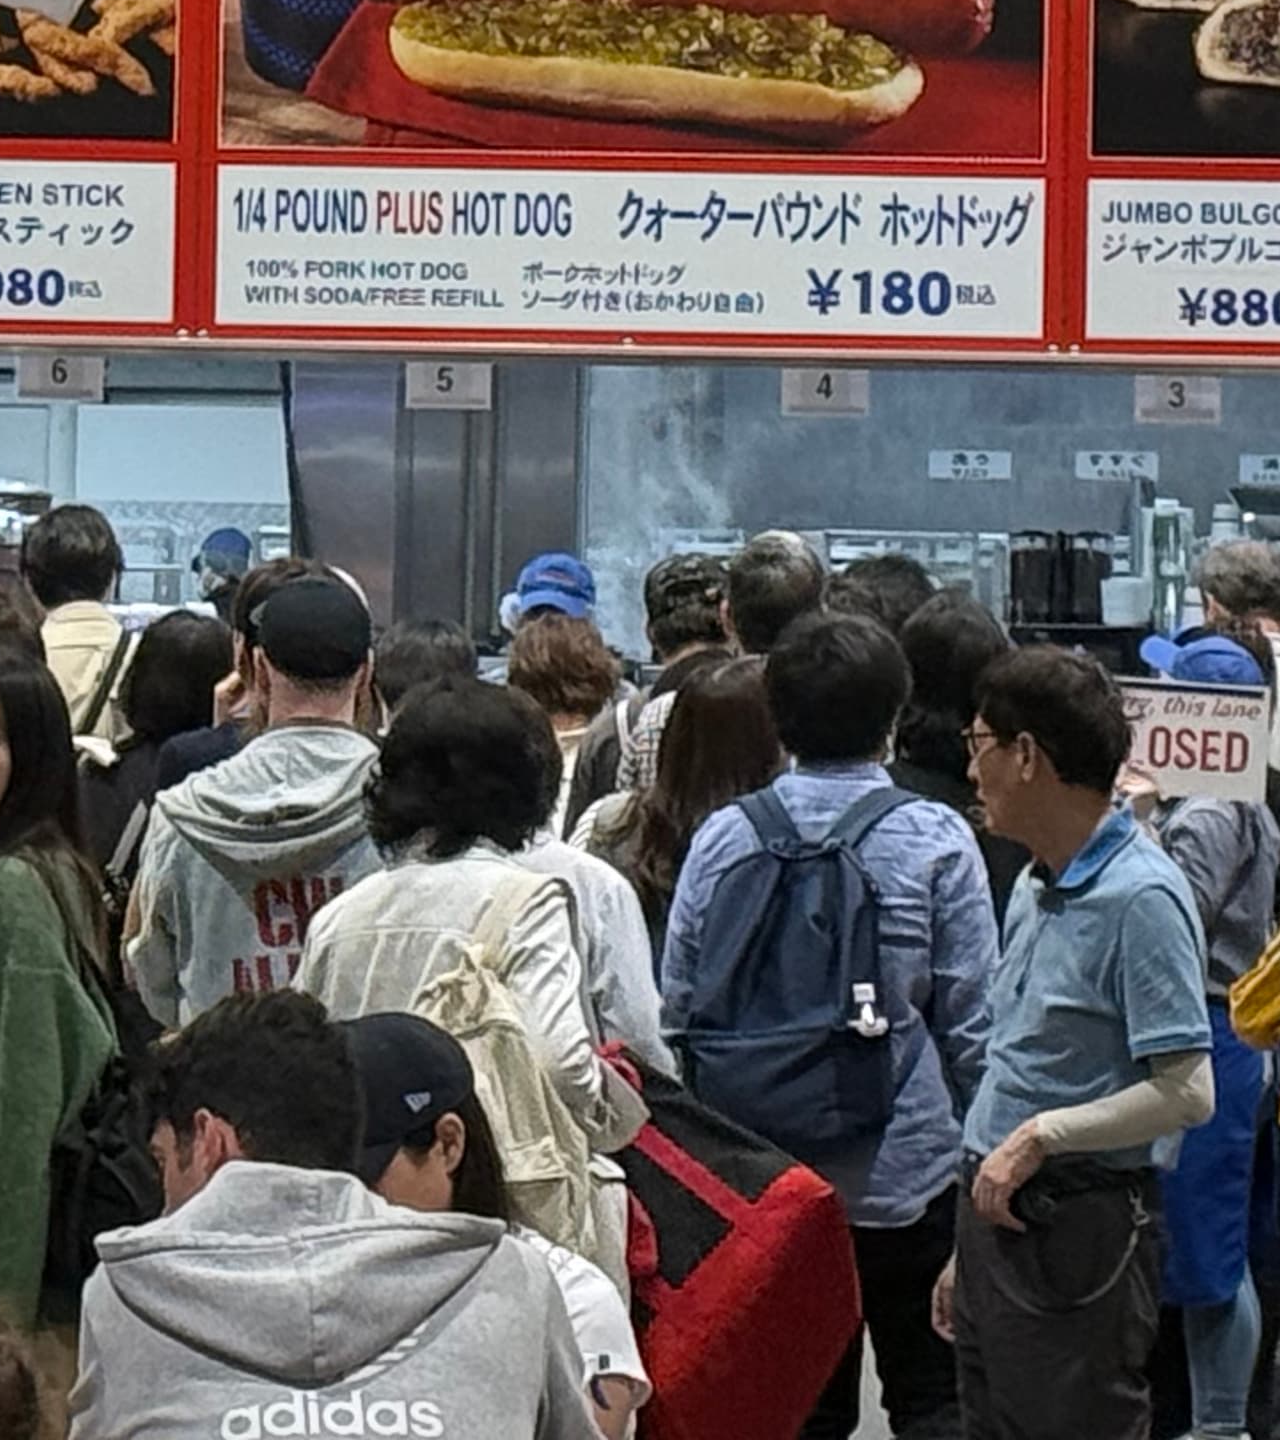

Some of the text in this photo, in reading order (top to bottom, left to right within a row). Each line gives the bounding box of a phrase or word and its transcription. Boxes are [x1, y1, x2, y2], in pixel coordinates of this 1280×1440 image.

[42, 184, 125, 208] STICK
[233, 188, 573, 237] 1/4 POUND PLUS HOT DOG
[618, 188, 1035, 249] クォーターパウンド ホットドッグ
[1101, 201, 1193, 224] JUMBO
[245, 259, 298, 279] 100%
[371, 261, 415, 280] HOT
[421, 262, 469, 281] DOG
[244, 285, 298, 305] WITH
[431, 288, 505, 308] REFILL
[51, 357, 69, 385] 6
[437, 366, 454, 393] 5
[817, 374, 834, 399] 4
[1168, 382, 1186, 408] 3
[1163, 696, 1206, 717] this
[1211, 697, 1262, 719] lane
[1148, 726, 1250, 773] OSED
[221, 1390, 445, 1439] adidas
